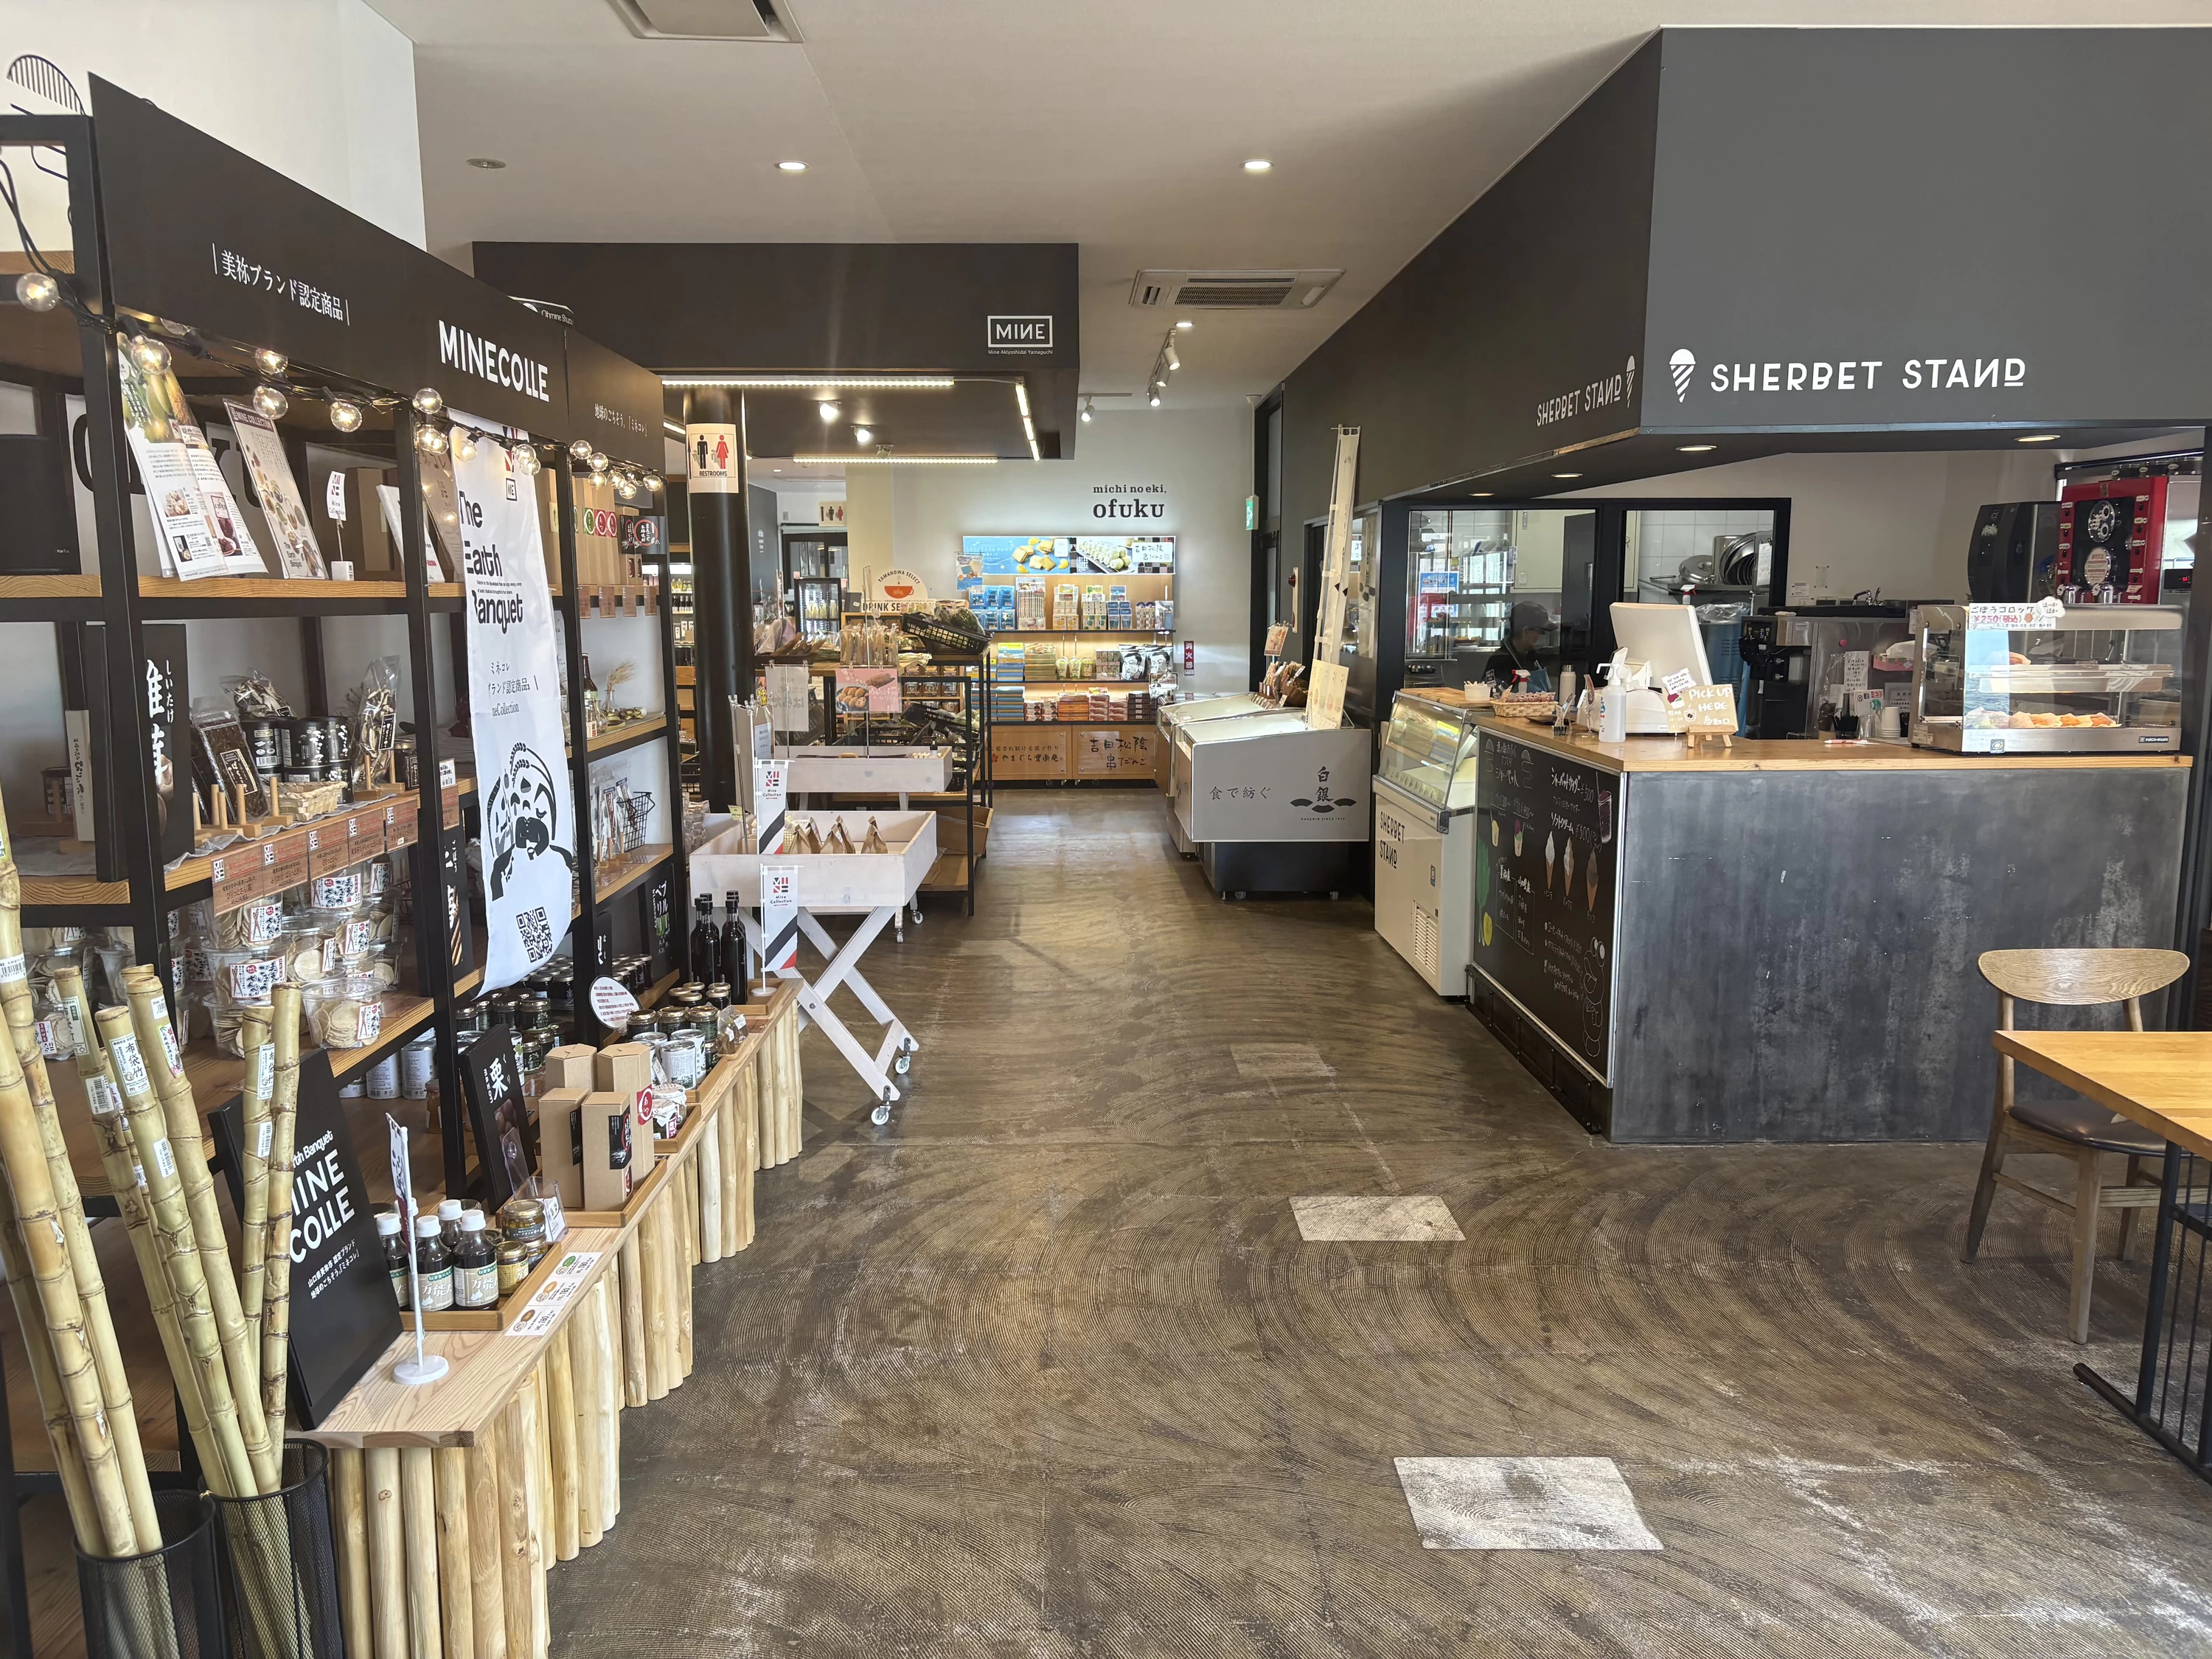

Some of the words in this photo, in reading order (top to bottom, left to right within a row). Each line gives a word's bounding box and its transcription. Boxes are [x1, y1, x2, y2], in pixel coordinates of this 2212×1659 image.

[221, 249, 343, 321] 美祢ブランド認定商品
[996, 324, 1046, 340] MINE
[439, 319, 549, 403] MINECOLLE
[1711, 361, 1883, 392] SHERBET
[1902, 358, 2025, 389] STAND
[1537, 389, 1580, 427] SHERBET
[1585, 374, 1622, 411] STAND
[1093, 484, 1127, 493] michi
[1146, 485, 1167, 494] eki,
[459, 490, 483, 528] The
[1093, 498, 1165, 518] ofuku
[465, 540, 503, 577] Earth
[905, 571, 920, 585] SELECT
[1970, 606, 2034, 614] ごぼうコロッケ
[491, 661, 510, 675] ミネコレ
[1185, 642, 1194, 669] 消火器
[164, 659, 174, 723] しいたけ
[1688, 687, 1716, 700] PICK
[1717, 687, 1733, 698] UP
[1698, 701, 1729, 712] HERE
[1089, 737, 1147, 753] 吉田松陰
[1106, 754, 1147, 770] 串だんご
[1315, 765, 1334, 802] 白銀
[1495, 768, 1519, 787] シャーベット
[1209, 786, 1271, 801] 食で紡ぐ
[1380, 811, 1405, 844] SHERBET
[1551, 812, 1574, 835] ソフトクリーム
[1380, 839, 1397, 869] STAND
[125, 1042, 145, 1077] 布袋竹
[502, 1053, 512, 1086] くり
[490, 1057, 509, 1102] 栗
[303, 1130, 333, 1158] Banquet
[289, 1185, 355, 1263] COLLE
